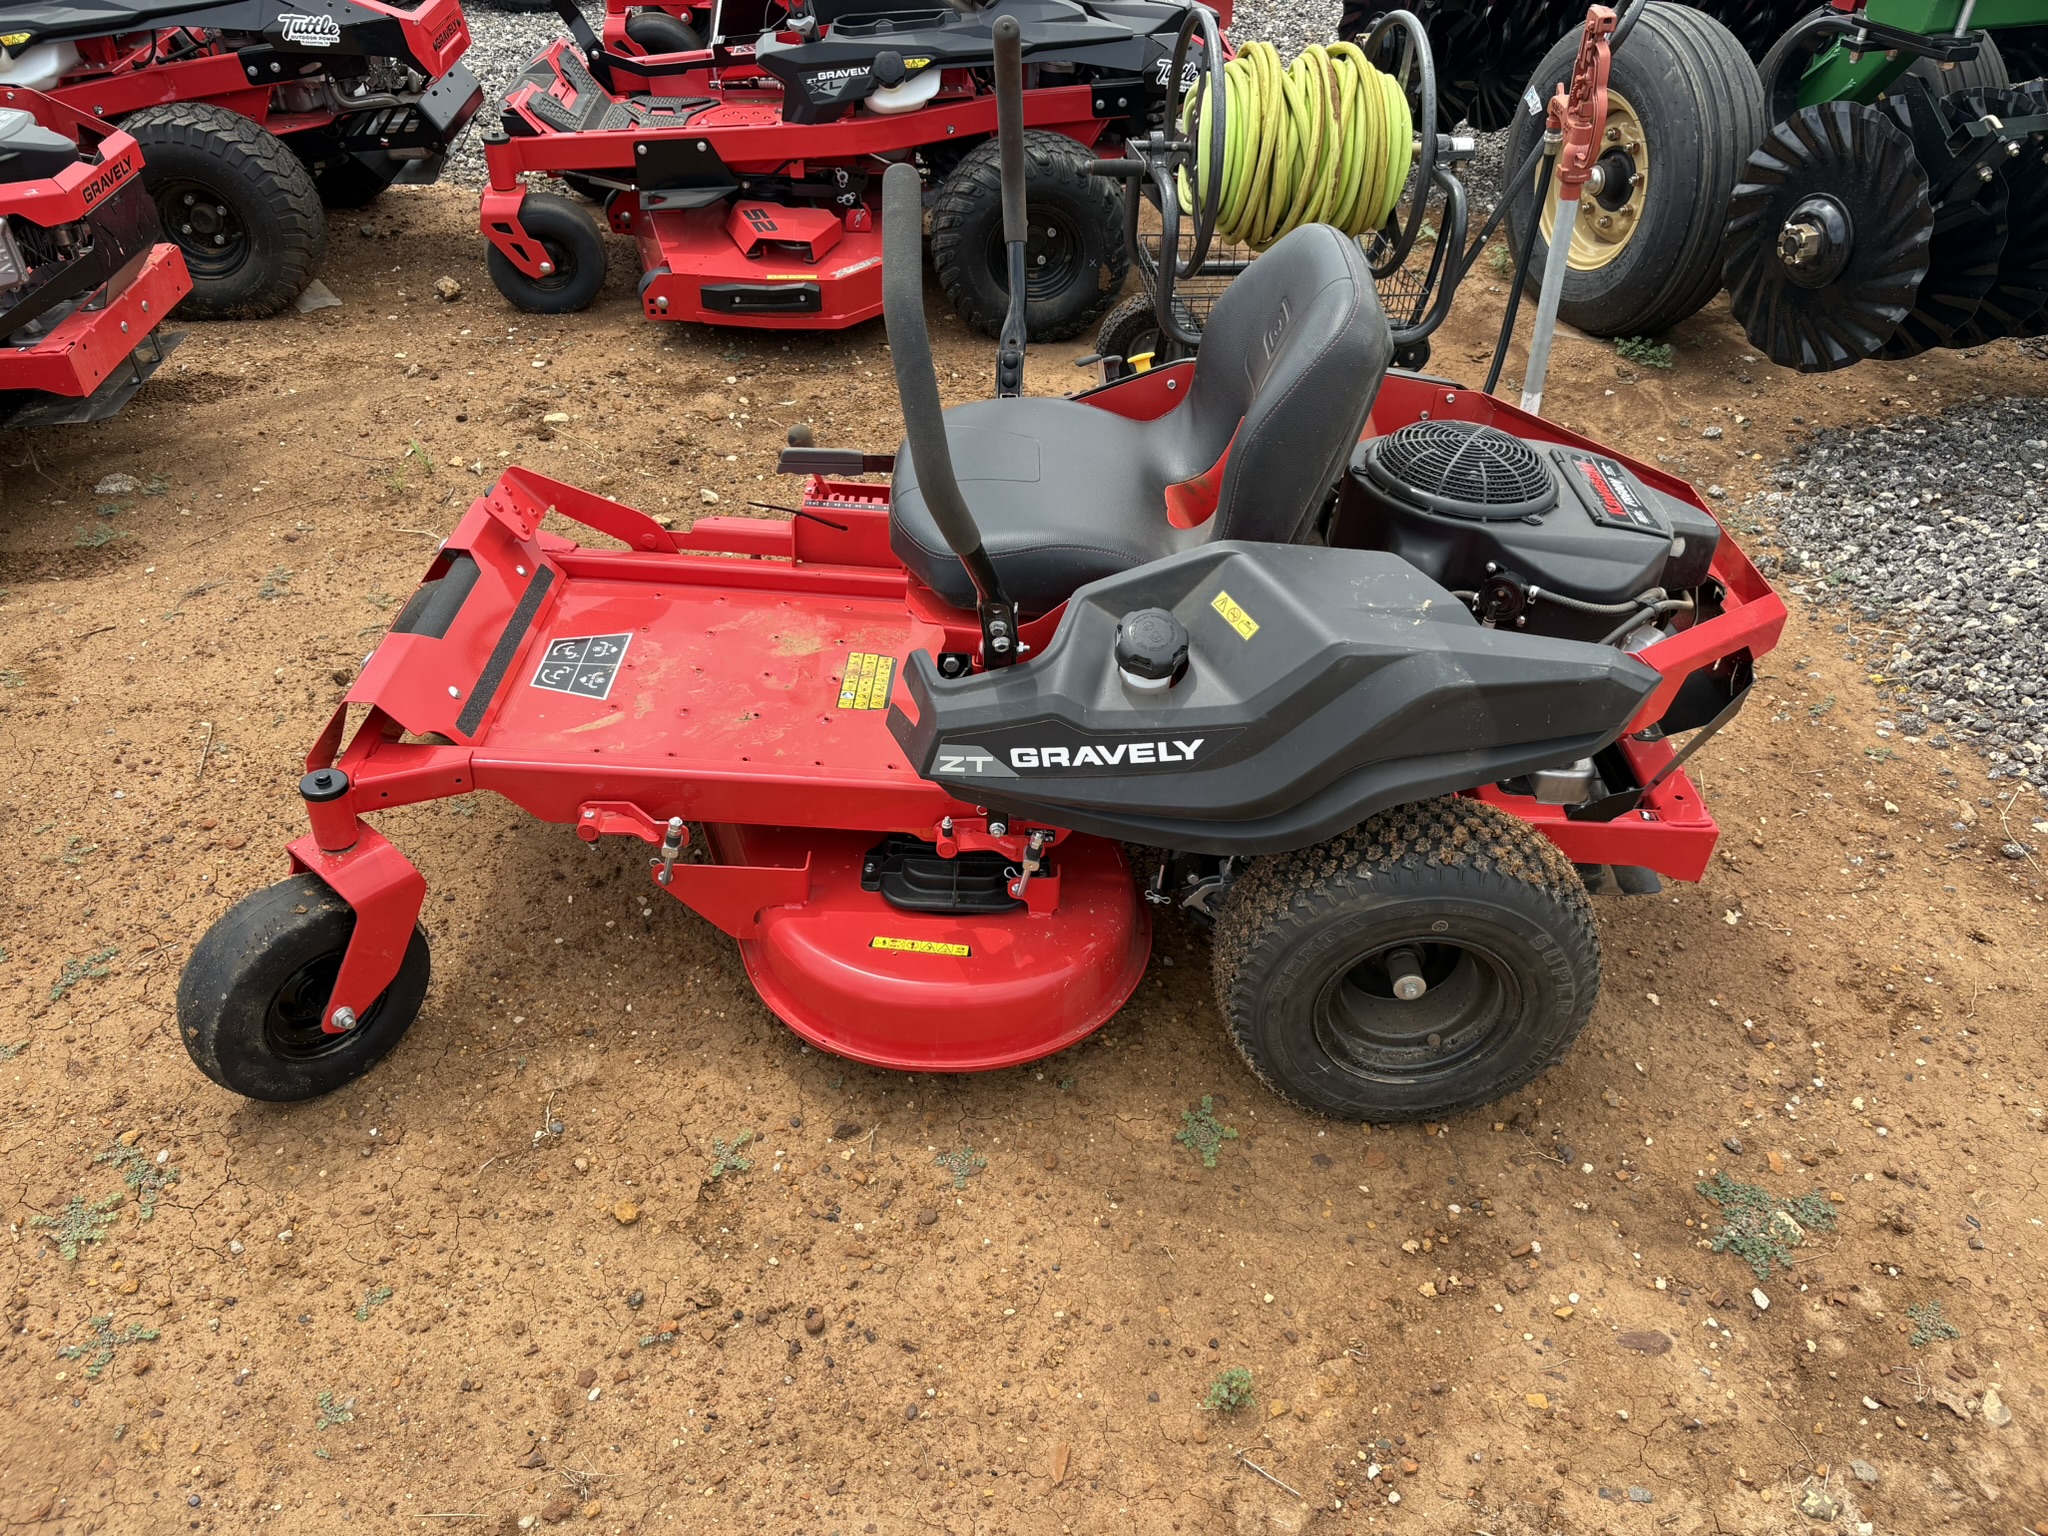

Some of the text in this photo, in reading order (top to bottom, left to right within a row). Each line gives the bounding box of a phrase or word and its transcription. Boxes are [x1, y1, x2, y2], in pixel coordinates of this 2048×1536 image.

[278, 14, 340, 42] Tuttle
[434, 19, 458, 50] GRAVELY
[806, 66, 871, 85] ZT GRAVELY
[809, 81, 842, 95] XL
[82, 154, 133, 205] GRAVELY
[742, 208, 778, 233] 52
[1573, 460, 1628, 517] Kawasaki
[939, 738, 1205, 773] ZT GRAVELY
[1274, 916, 1363, 996] KENDA
[1529, 932, 1575, 1017] SUPER
